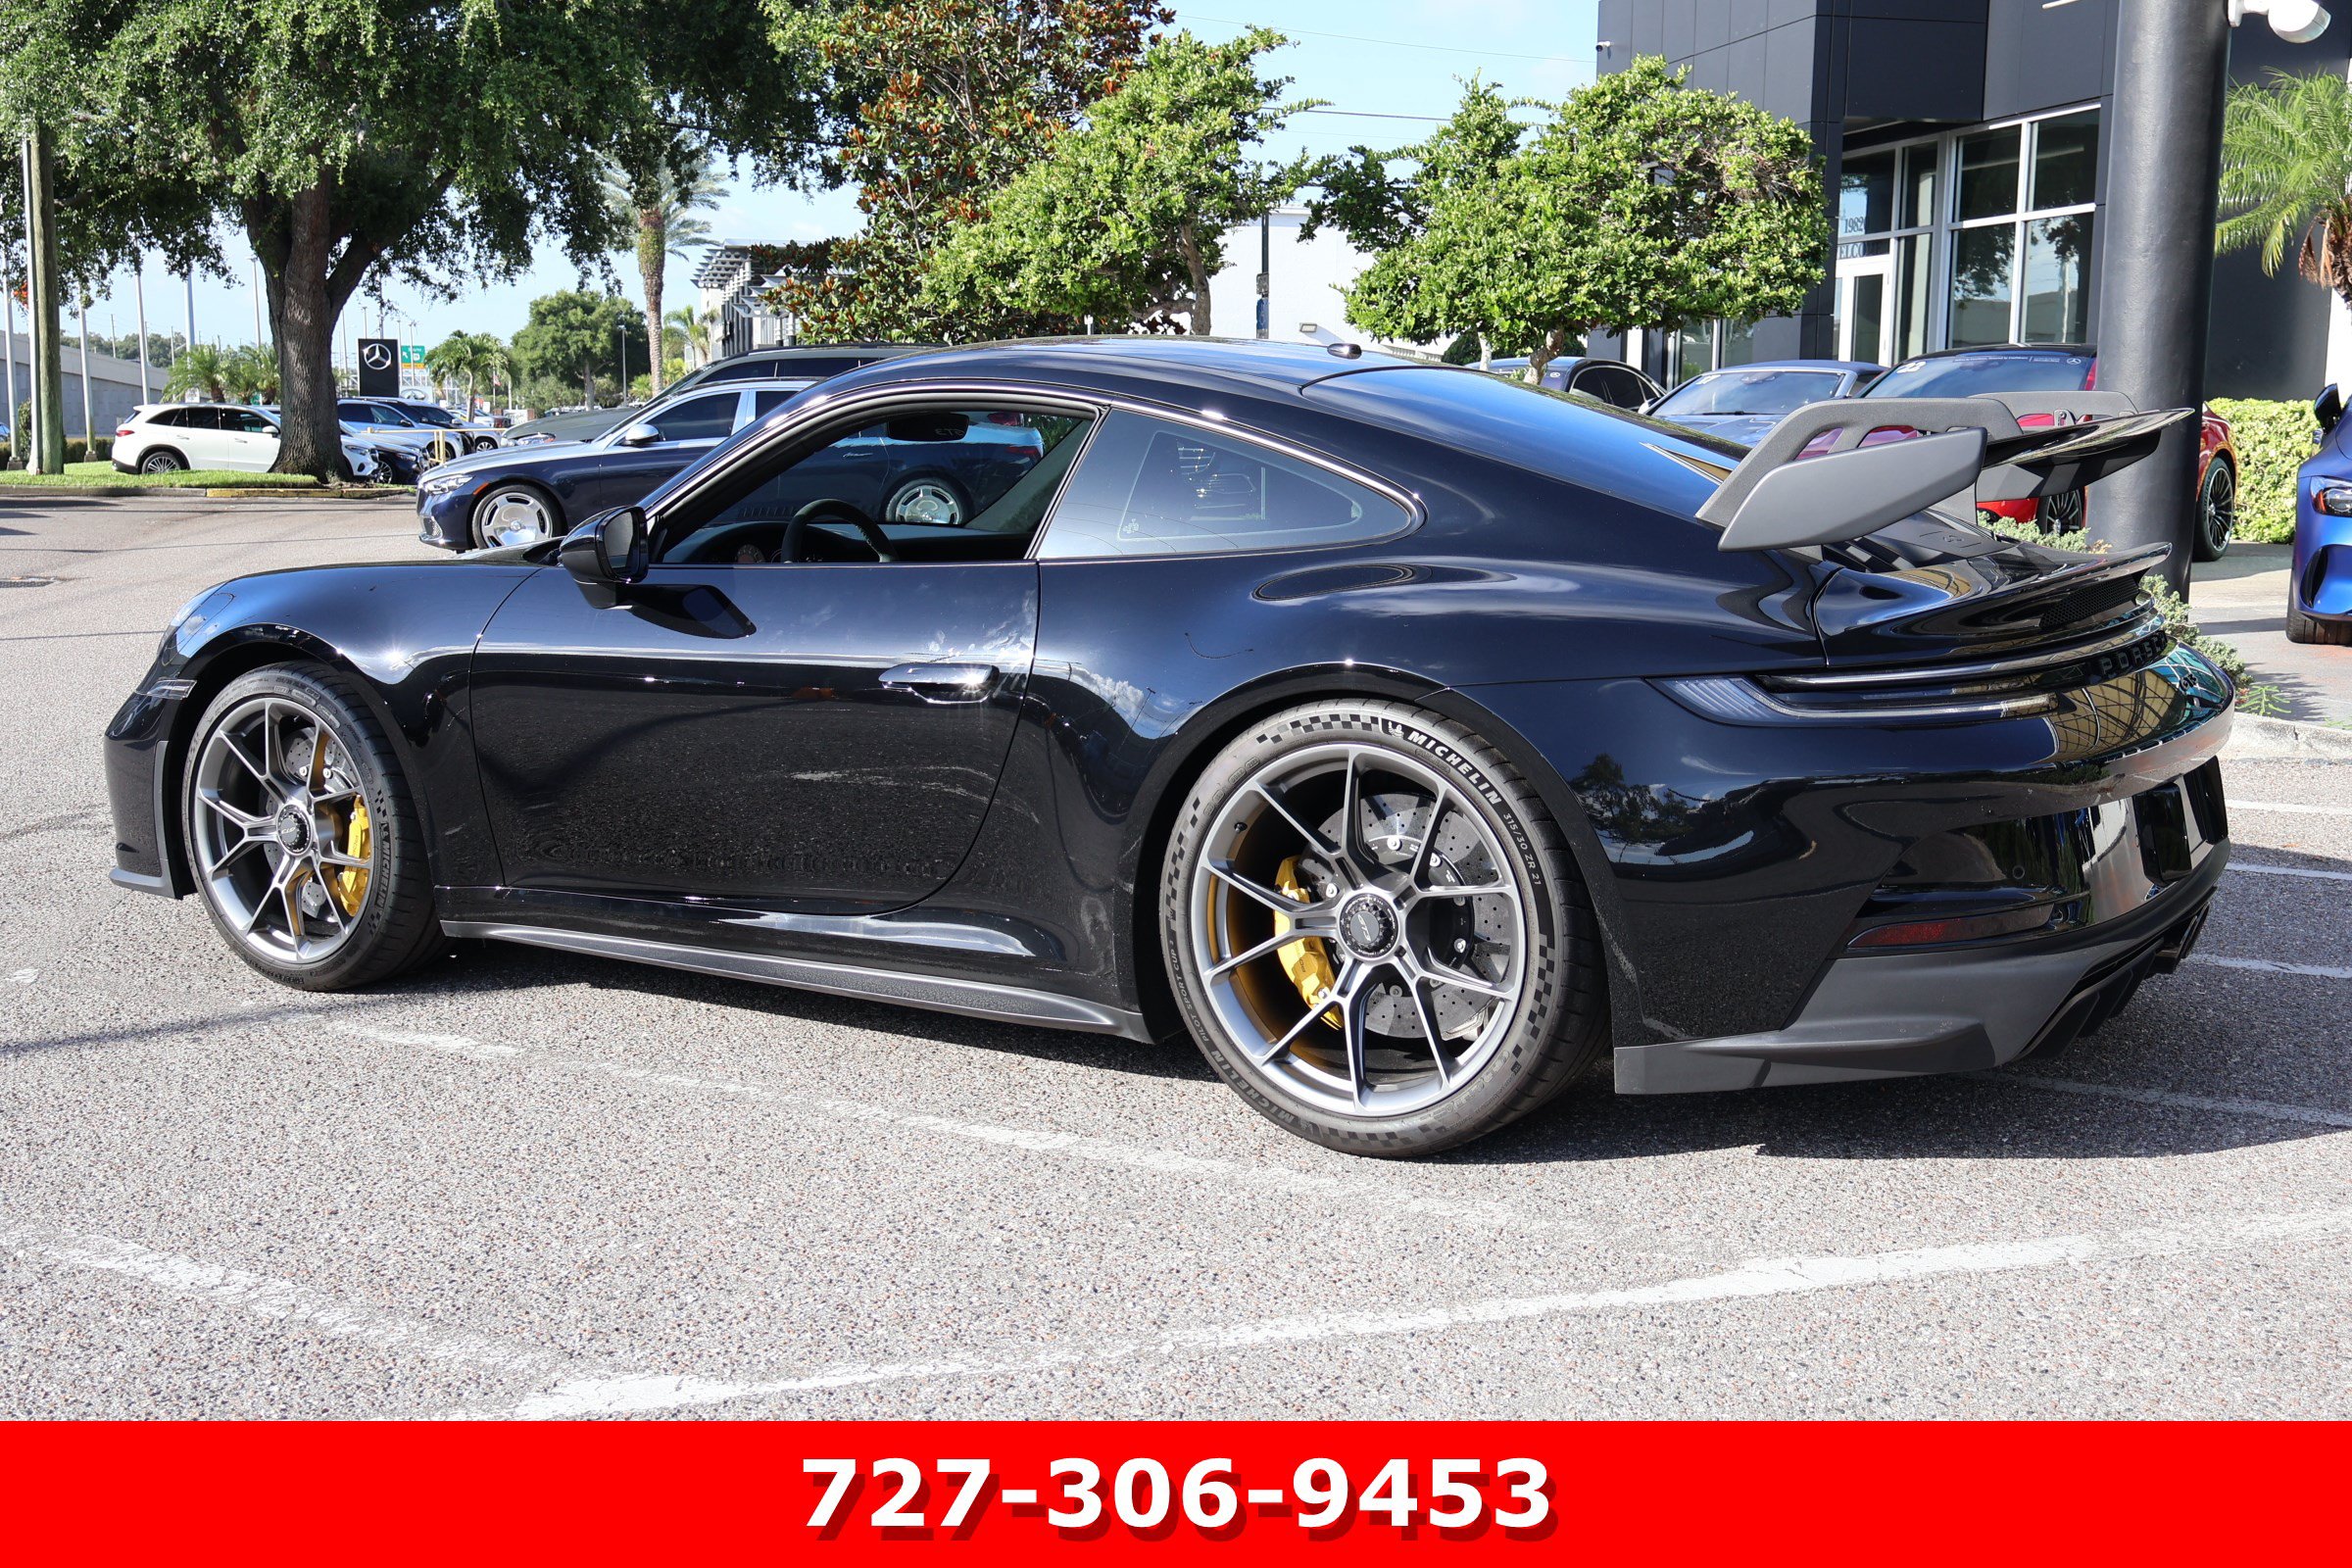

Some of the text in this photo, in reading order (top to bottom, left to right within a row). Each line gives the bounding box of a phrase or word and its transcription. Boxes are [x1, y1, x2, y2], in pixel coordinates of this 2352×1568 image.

[2098, 631, 2166, 675] PORSC
[1408, 729, 1502, 806] MICHELIN
[1502, 812, 1529, 851] 315/30
[1524, 854, 1537, 870] ZR
[1531, 872, 1543, 886] 21
[373, 841, 391, 909] MICHELIN
[1170, 948, 1180, 972] CUP
[1176, 975, 1193, 1010] SPORT
[1191, 1012, 1209, 1043] PILOT
[1210, 1050, 1296, 1126] MICHELIN
